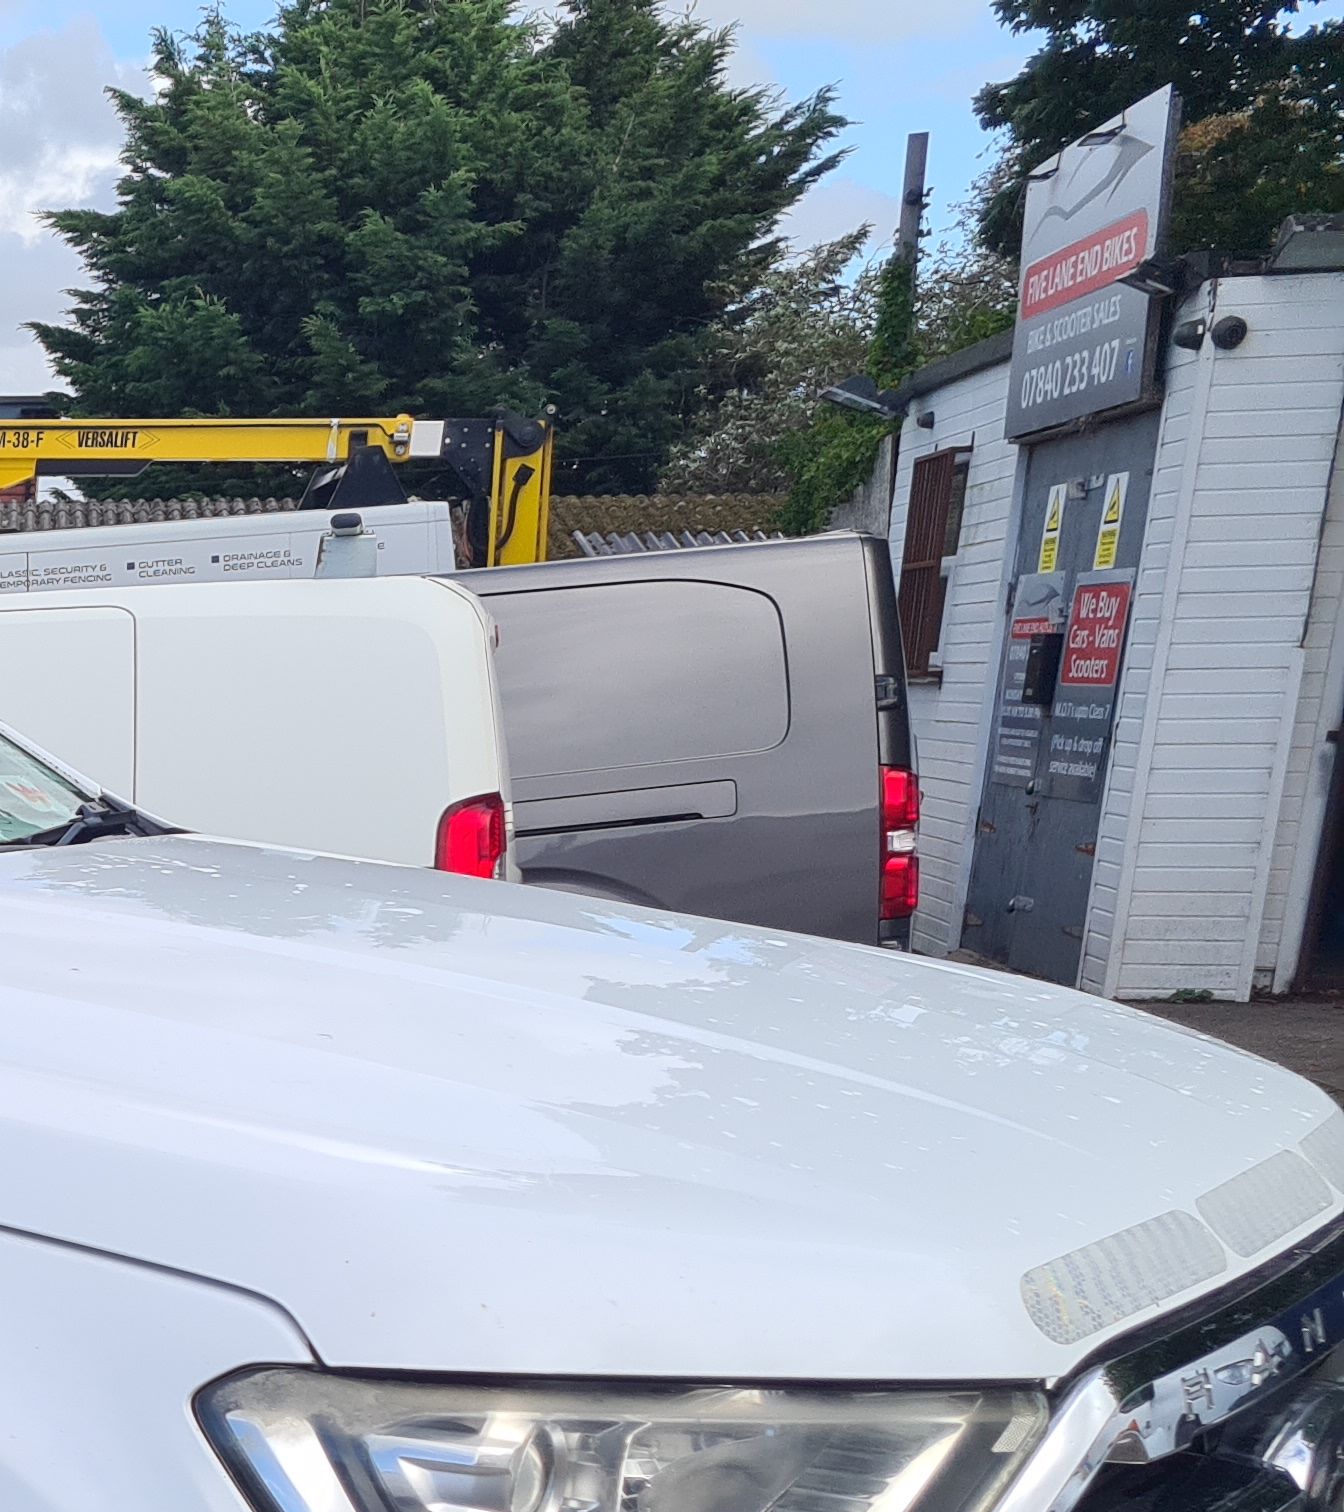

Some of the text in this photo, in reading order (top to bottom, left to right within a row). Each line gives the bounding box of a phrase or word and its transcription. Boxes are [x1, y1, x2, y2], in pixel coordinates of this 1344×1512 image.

[1027, 227, 1138, 306] FIVE LANE END BIKES
[1027, 294, 1121, 354] BIKE & SCOOTER SALES
[1021, 339, 1119, 408] 07840 233 407
[77, 430, 139, 448] VERSALIFT
[223, 550, 280, 562] DRAINAGE
[223, 558, 303, 572] DEEP CLEANS
[44, 564, 97, 576] SECURITY
[63, 573, 112, 585] FENCING
[138, 558, 195, 578] GUTTER CLEANING
[1080, 591, 1120, 626] We Buy
[1069, 625, 1089, 648] Cars
[1094, 624, 1119, 648] Vans
[1069, 654, 1108, 678] Scooters
